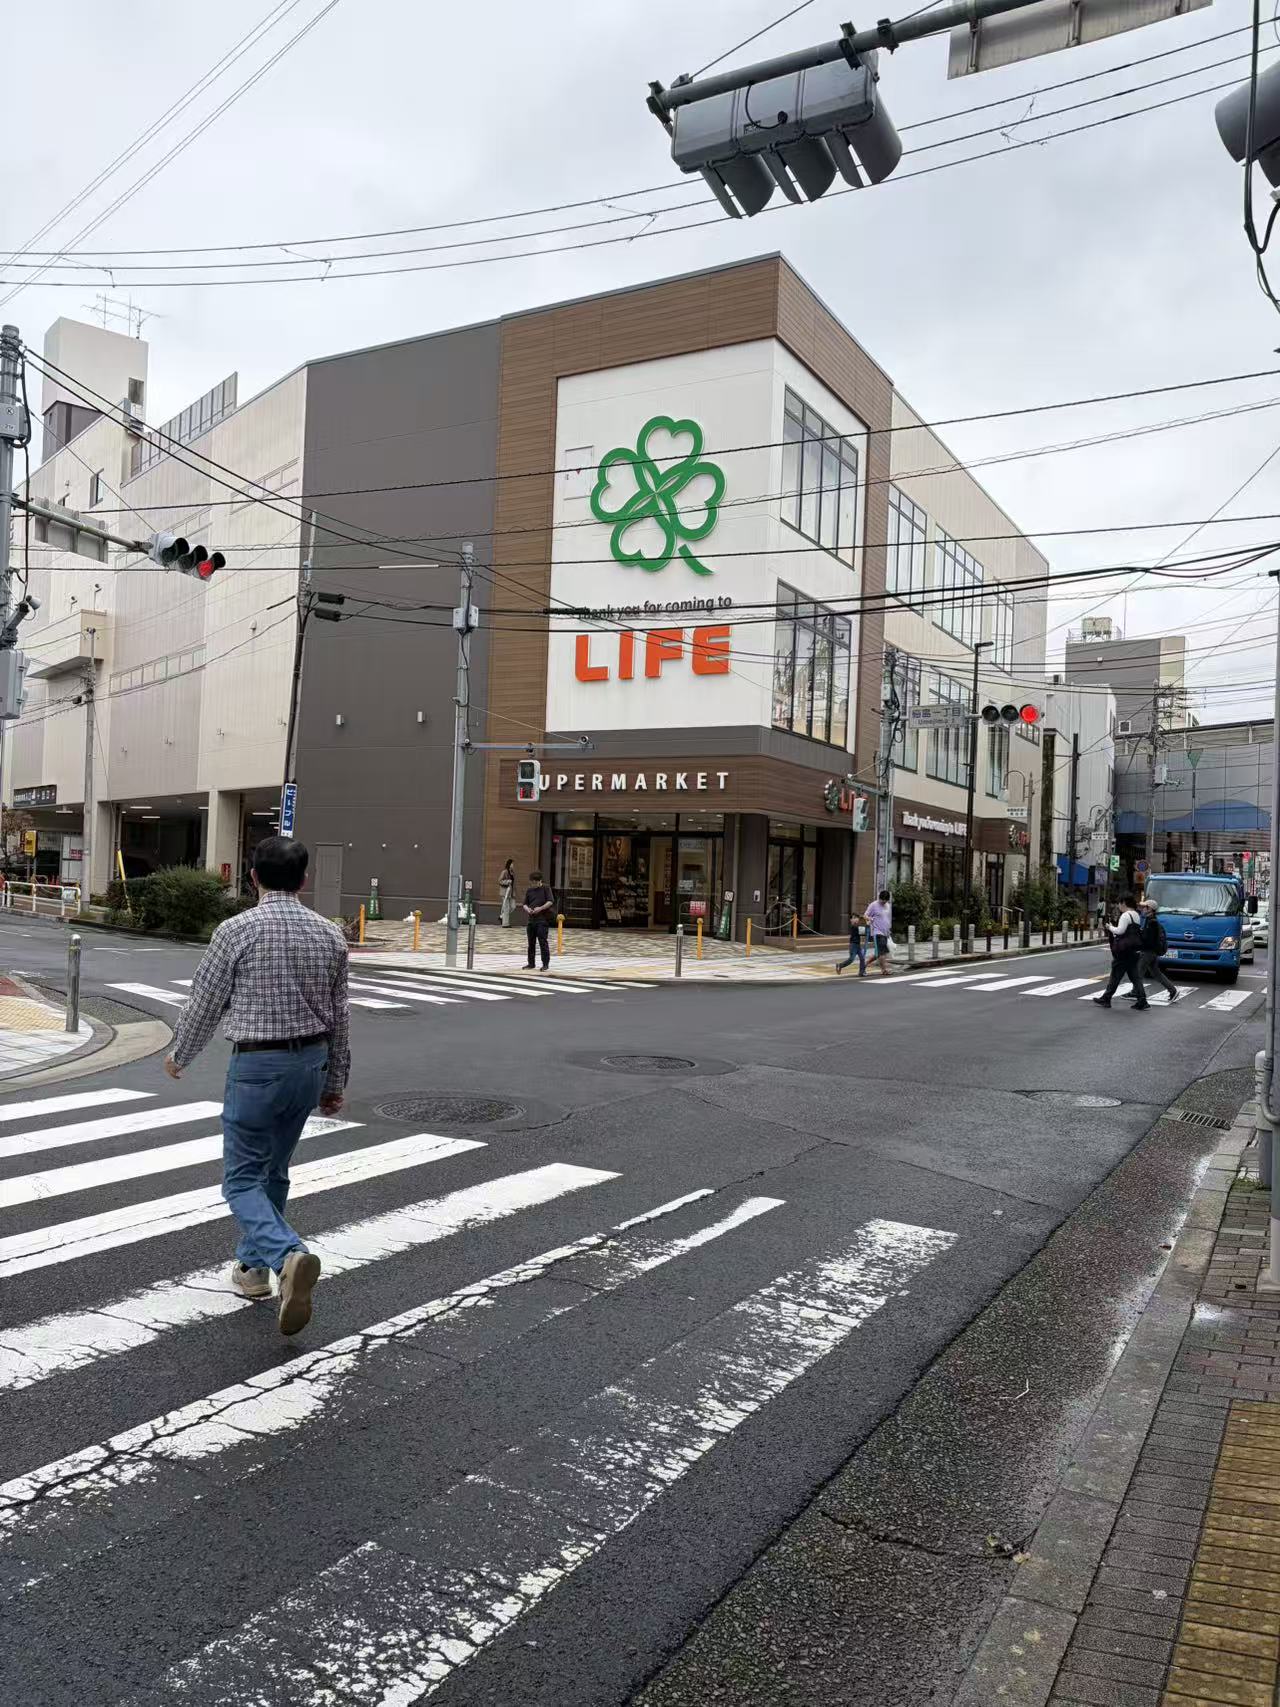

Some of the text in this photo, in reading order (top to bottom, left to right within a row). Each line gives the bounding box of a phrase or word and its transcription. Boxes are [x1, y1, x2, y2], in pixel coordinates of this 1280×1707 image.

[577, 595, 732, 620] hank you for coming to
[575, 625, 731, 682] LIFE
[539, 771, 729, 791] UPERMARKET
